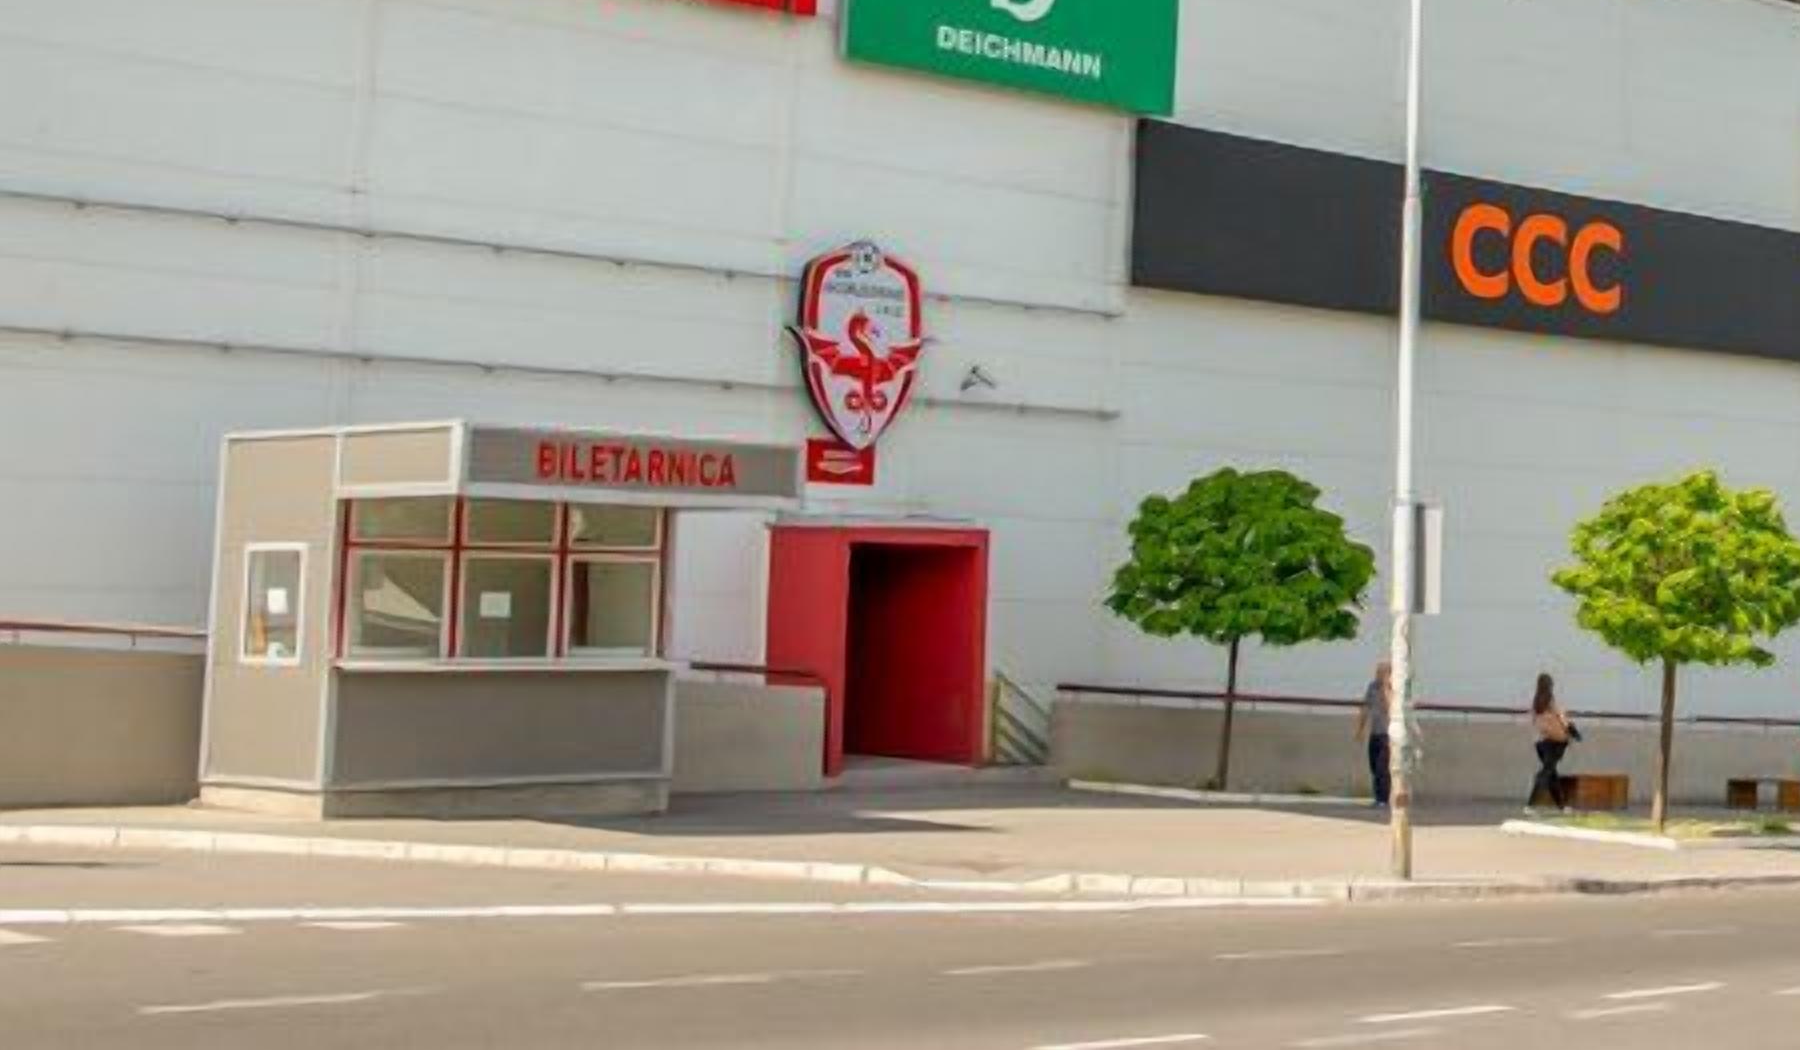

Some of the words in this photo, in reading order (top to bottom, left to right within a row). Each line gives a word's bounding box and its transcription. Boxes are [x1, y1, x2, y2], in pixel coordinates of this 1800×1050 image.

[936, 25, 1101, 79] DEICHMANN
[1452, 203, 1625, 315] CCC
[536, 441, 735, 487] BILETARNICA
